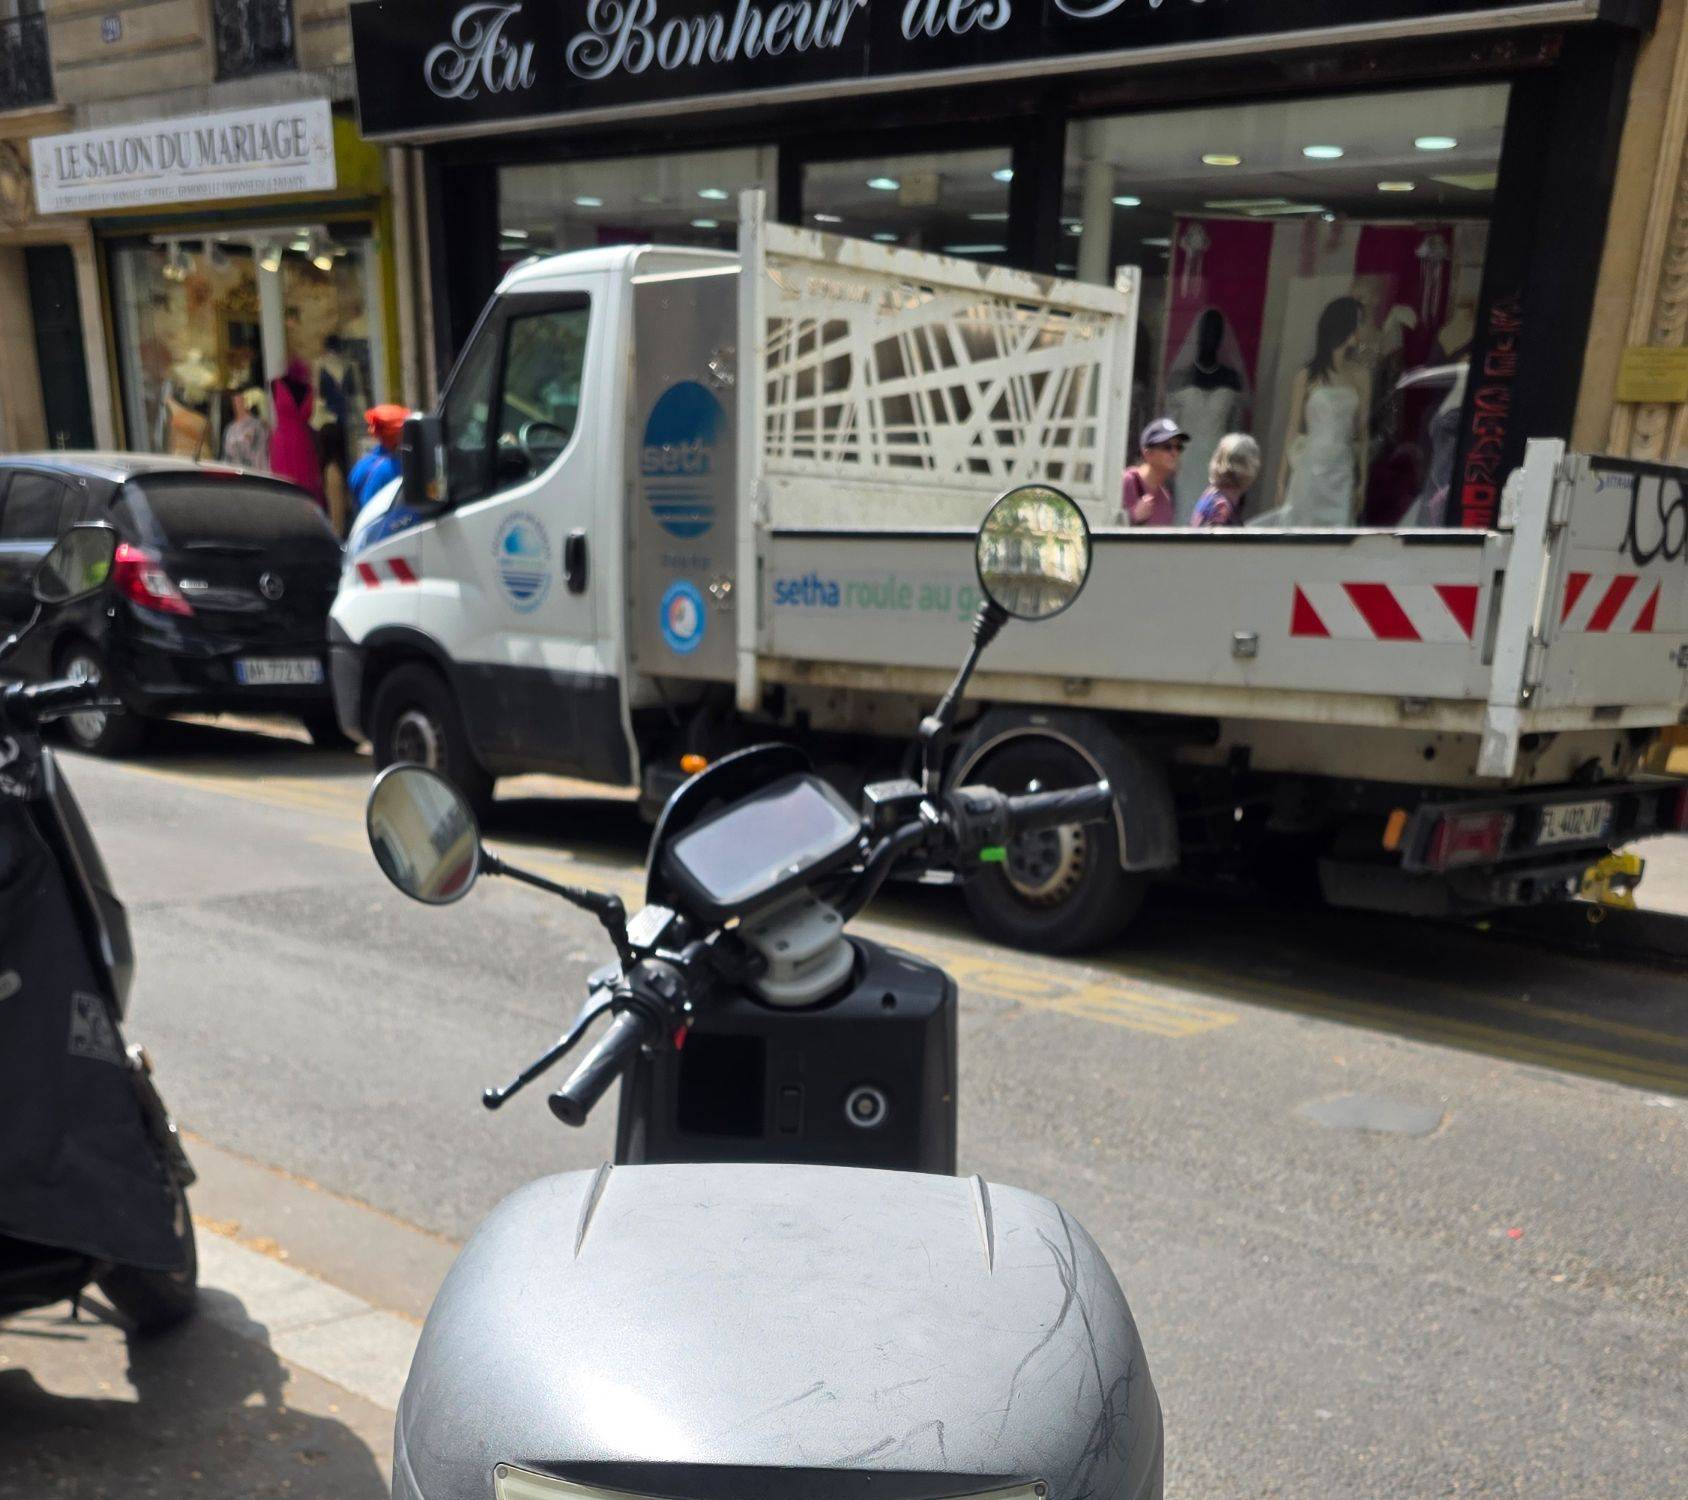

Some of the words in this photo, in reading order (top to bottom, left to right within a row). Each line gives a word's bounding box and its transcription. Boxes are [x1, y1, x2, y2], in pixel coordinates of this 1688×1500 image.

[423, 3, 535, 100] Au
[565, 0, 866, 80] Bonheur
[54, 145, 83, 181] LE
[84, 135, 153, 177] SALON
[154, 130, 193, 170] DU
[194, 117, 309, 164] MARIAGE
[774, 570, 840, 608] setha
[917, 582, 952, 612] au
